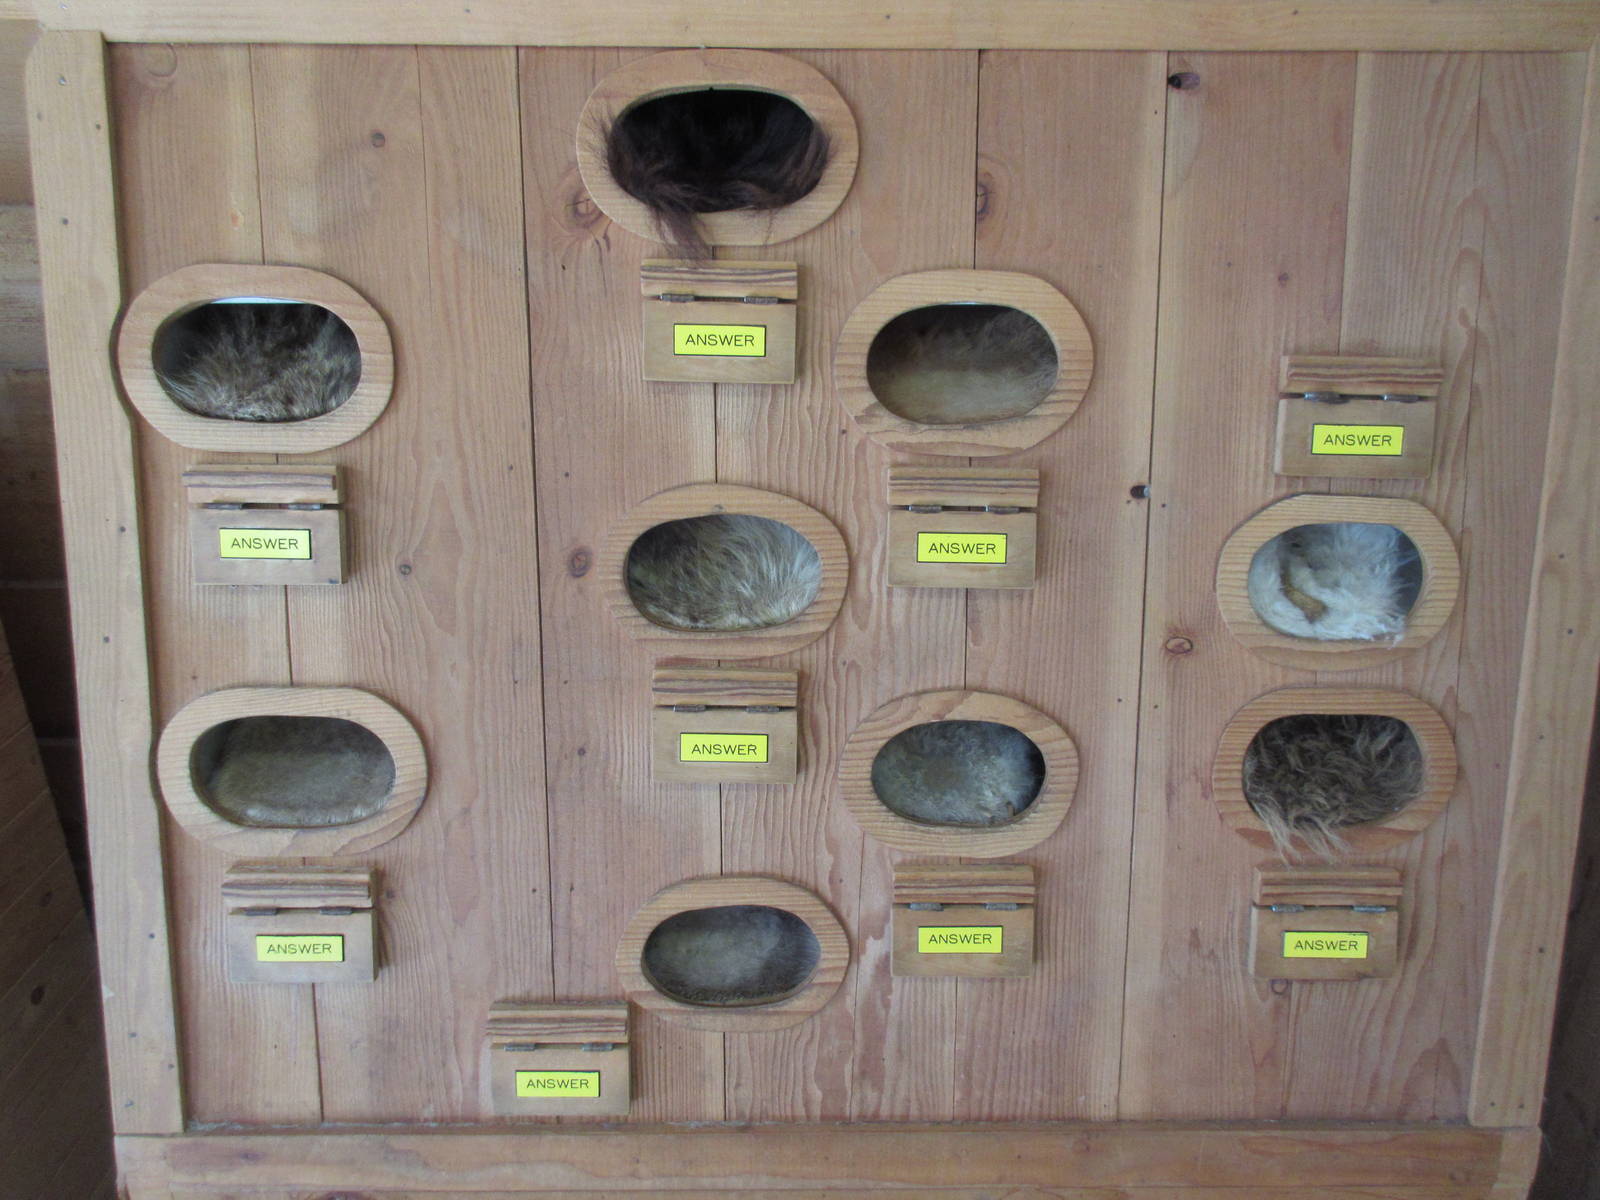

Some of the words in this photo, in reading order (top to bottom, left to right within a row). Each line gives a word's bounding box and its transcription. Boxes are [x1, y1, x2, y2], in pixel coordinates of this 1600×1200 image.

[685, 333, 755, 347] ANSWER
[1323, 433, 1392, 447] ANSWER
[230, 536, 299, 550] ANSWER
[928, 542, 997, 555] ANSWER
[691, 743, 758, 756] ANSWER
[928, 934, 993, 945] ANSWER
[1294, 939, 1359, 951] ANSWER
[266, 942, 332, 954] ANSWER
[526, 1078, 590, 1089] ANSWER
